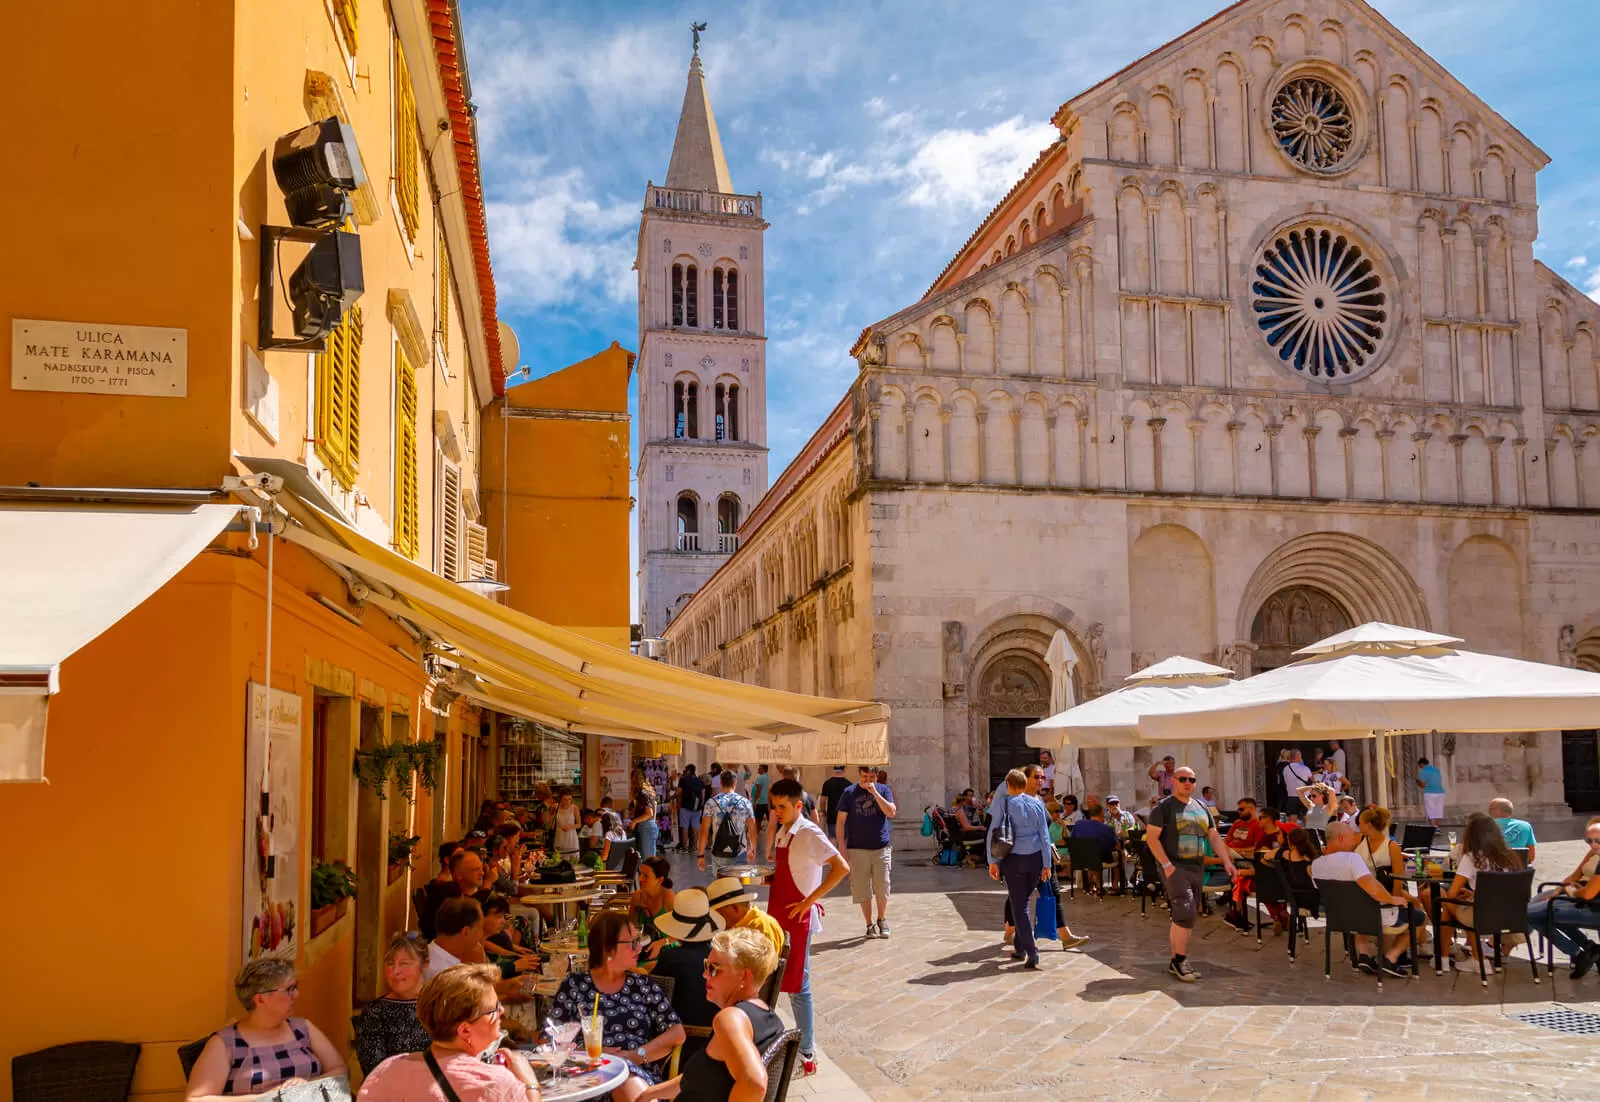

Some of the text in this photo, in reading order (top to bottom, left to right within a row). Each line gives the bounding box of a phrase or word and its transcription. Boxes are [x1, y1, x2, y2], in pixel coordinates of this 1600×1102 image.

[76, 331, 124, 344] ULICA
[25, 345, 173, 364] MATE KARAMANA
[44, 363, 108, 374] NADBISKUPA
[127, 367, 156, 376] PISCA
[71, 376, 95, 385] 1700
[108, 377, 128, 387] 1771
